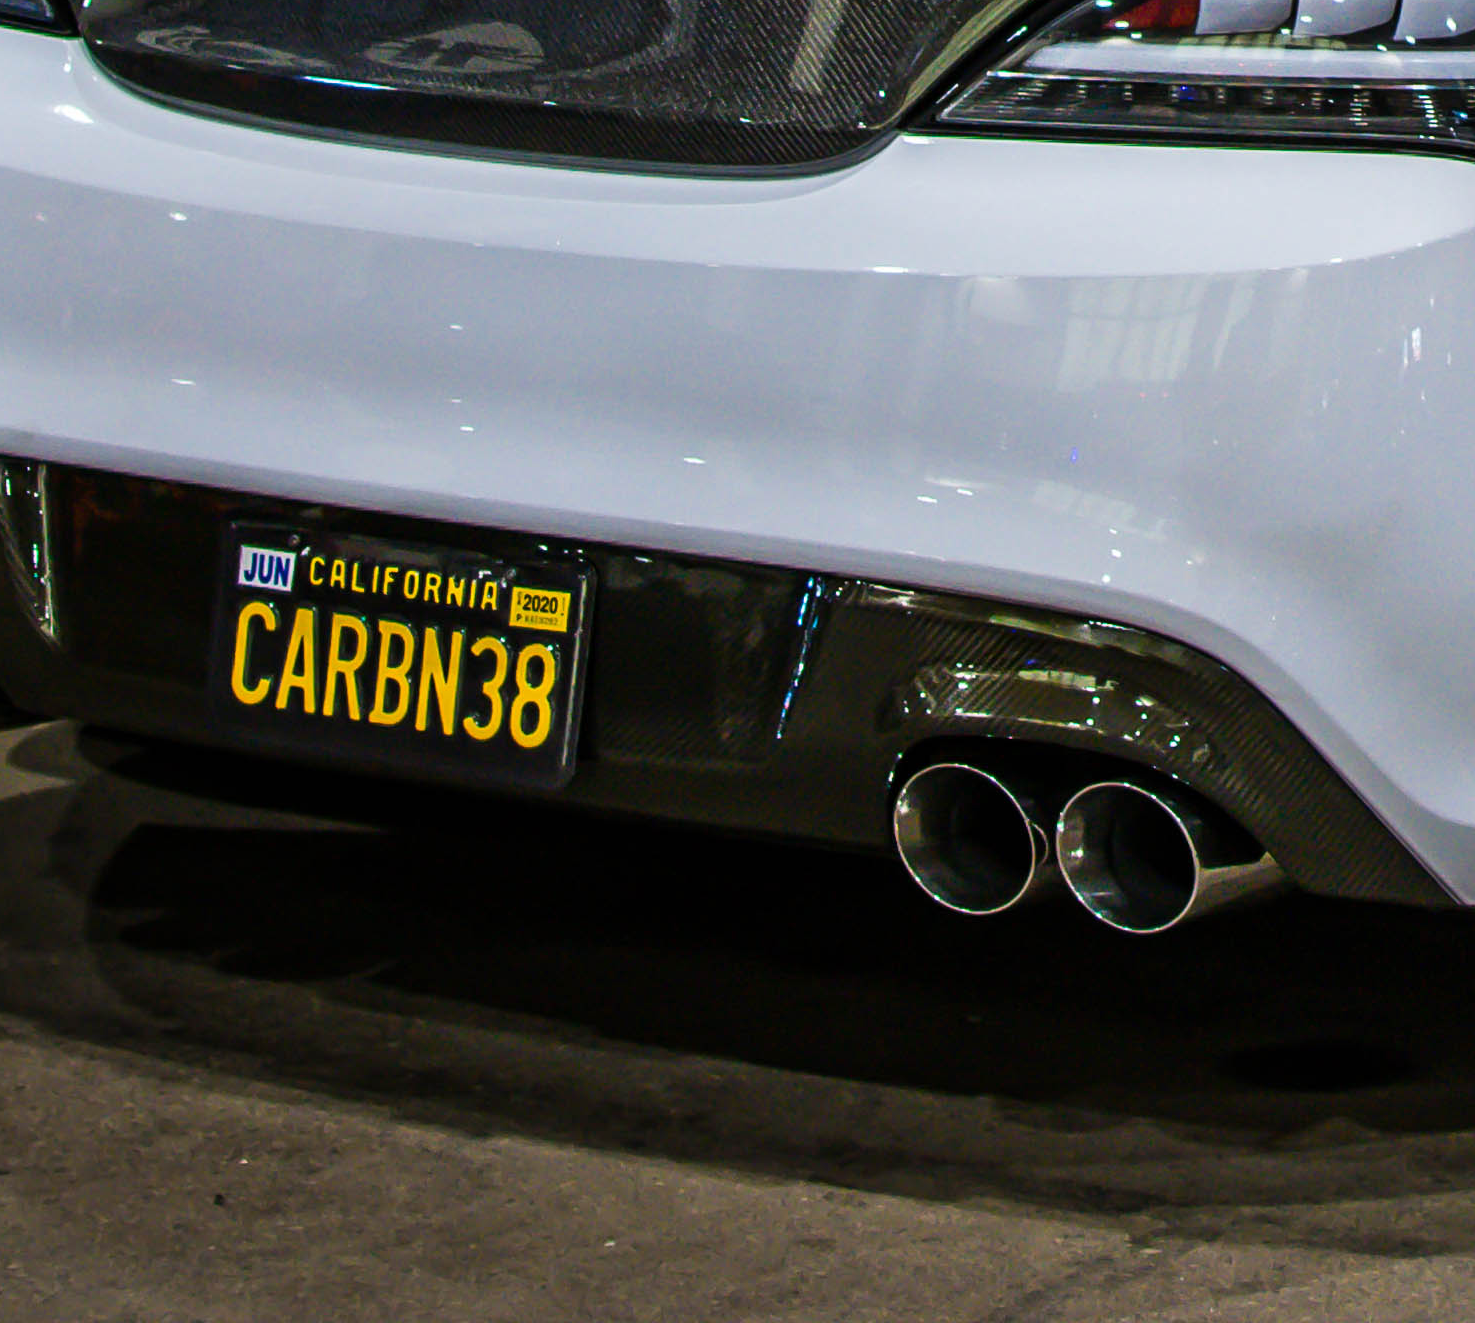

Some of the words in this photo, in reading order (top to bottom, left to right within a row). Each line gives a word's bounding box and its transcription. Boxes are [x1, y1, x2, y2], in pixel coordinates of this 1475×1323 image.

[243, 552, 291, 588] JUN
[309, 556, 498, 611] CALIFORNIA
[522, 593, 559, 615] 2020
[230, 601, 556, 749] CARBN38
